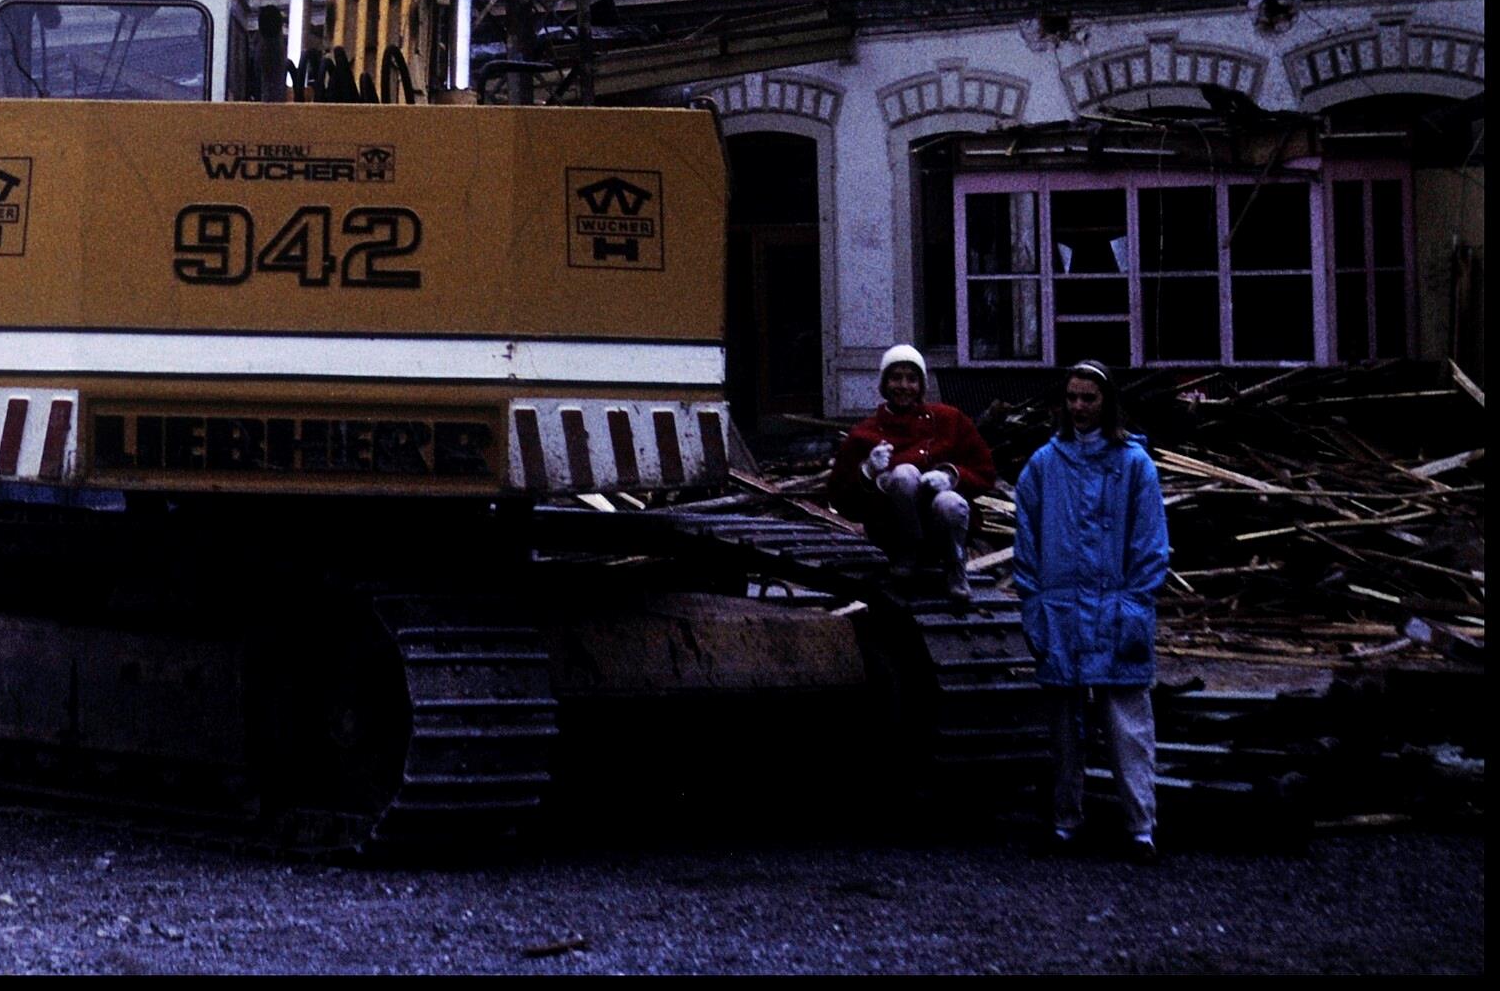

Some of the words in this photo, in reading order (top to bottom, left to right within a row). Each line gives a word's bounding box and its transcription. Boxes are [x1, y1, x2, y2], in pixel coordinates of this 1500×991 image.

[202, 156, 355, 181] WUCHER
[174, 204, 422, 288] 942
[581, 220, 651, 232] WUCHER
[95, 415, 493, 473] LIEBHERR
